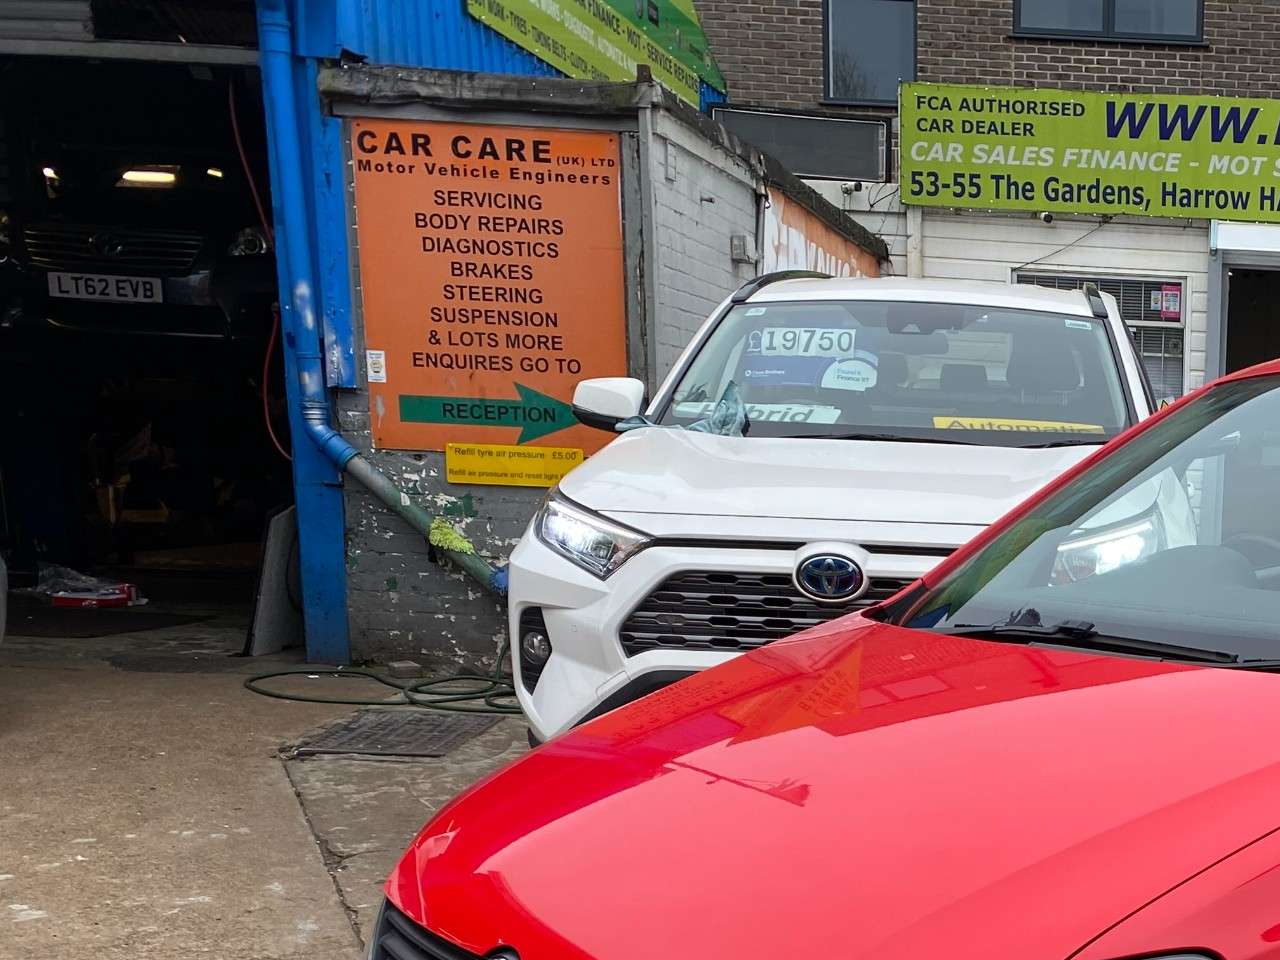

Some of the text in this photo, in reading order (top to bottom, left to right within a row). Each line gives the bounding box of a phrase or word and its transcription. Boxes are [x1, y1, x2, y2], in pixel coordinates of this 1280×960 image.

[916, 96, 1085, 118] FCA AUTHORISED
[916, 117, 1035, 137] CAR DEALER
[357, 130, 615, 168] CAR CARE (UK) LTD
[910, 142, 964, 164] CAR
[971, 144, 1054, 168] SALES
[1062, 148, 1182, 173] FINANCE
[1207, 155, 1268, 177] MOT
[358, 159, 611, 186] Motor Vehicle Engineers
[433, 189, 543, 211] SERVICING
[910, 171, 982, 198] 53-55
[990, 174, 1035, 201] The
[1043, 176, 1151, 212] Gardens,
[1161, 181, 1251, 211] Harrow
[415, 212, 564, 236] BODY REPAIRS
[422, 236, 560, 259] DIAGNOSTICS
[450, 261, 534, 281] BRAKES
[57, 275, 154, 299] LT62 EVB
[443, 284, 544, 305] STEERING
[430, 306, 559, 328] SUSPENSION
[448, 331, 499, 349] LOTS
[505, 333, 564, 351] MORE
[412, 352, 582, 375] ENQUIRES GO TO
[442, 403, 556, 424] RECEPTION
[697, 403, 814, 422] Hbrid
[948, 420, 1093, 433] Automati
[454, 447, 475, 456] Refill
[478, 448, 493, 458] tyre
[509, 451, 545, 461] pressure
